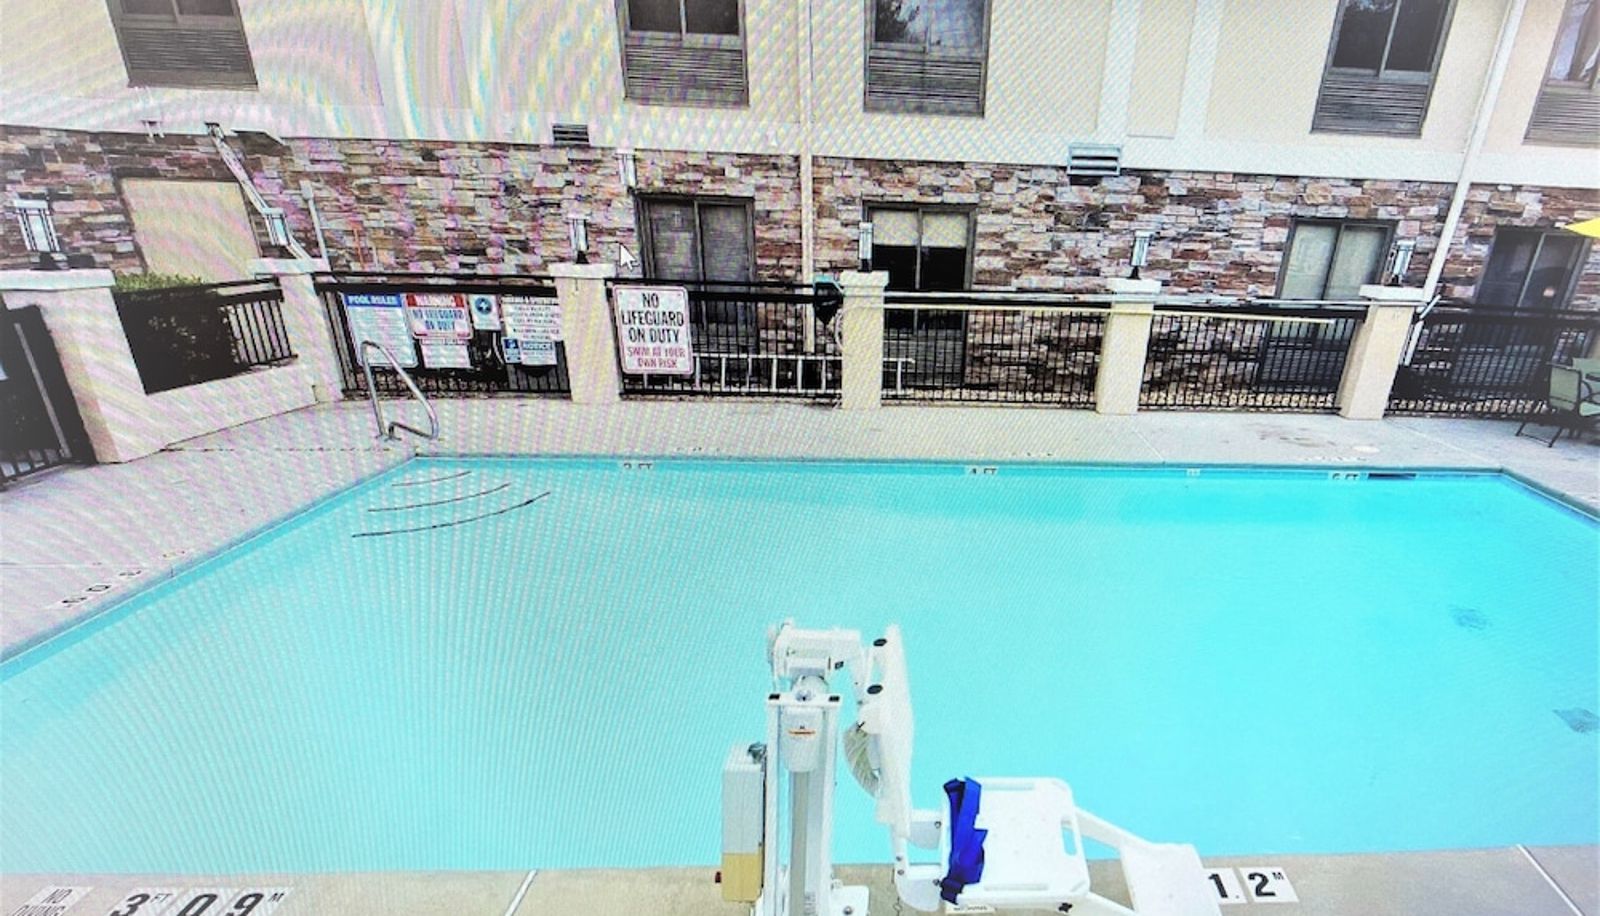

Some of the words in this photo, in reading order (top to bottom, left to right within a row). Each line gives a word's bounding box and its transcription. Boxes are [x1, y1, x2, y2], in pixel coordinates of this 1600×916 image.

[347, 294, 371, 305] POOL
[371, 294, 398, 305] RULES
[642, 292, 660, 308] NO
[412, 308, 424, 320] NO
[425, 308, 465, 320] LIFEGUARD
[621, 309, 684, 327] LIFEGUARD
[628, 326, 646, 343] ON
[648, 327, 680, 344] DUTY
[627, 346, 650, 357] SWIM
[652, 347, 662, 357] AT
[665, 347, 686, 358] YOUR
[638, 358, 657, 367] OWN
[658, 358, 678, 369] RISK
